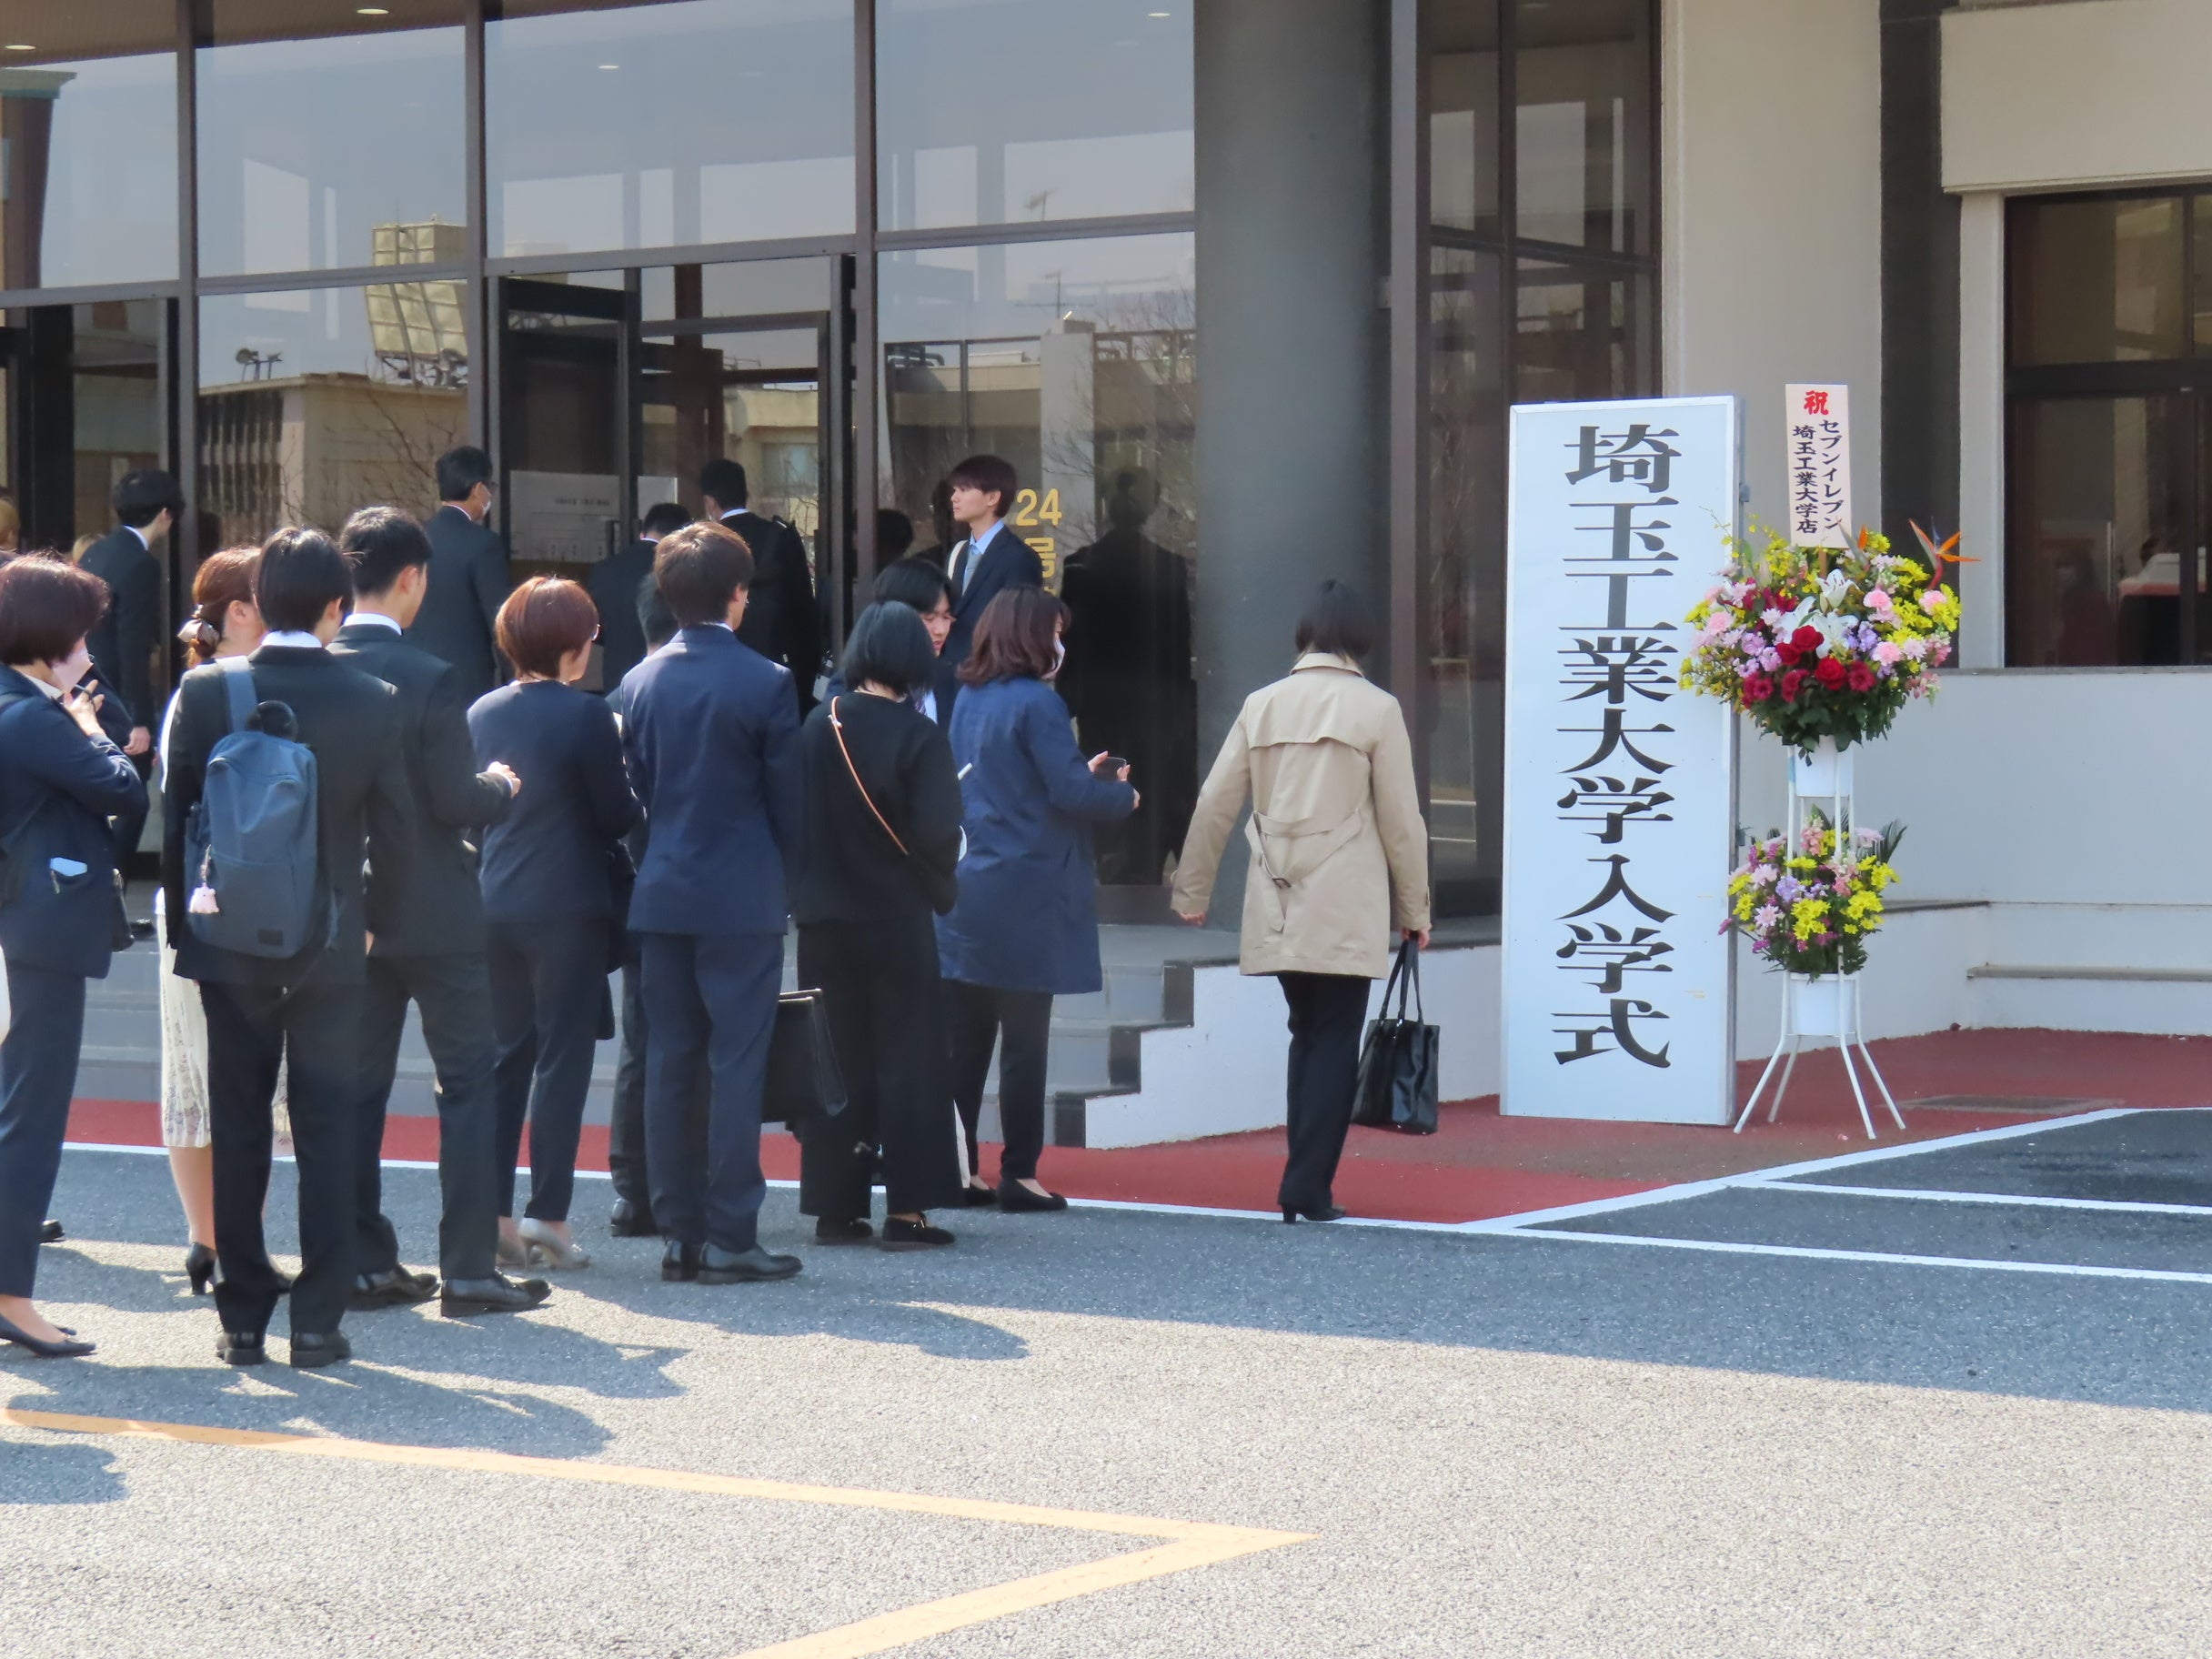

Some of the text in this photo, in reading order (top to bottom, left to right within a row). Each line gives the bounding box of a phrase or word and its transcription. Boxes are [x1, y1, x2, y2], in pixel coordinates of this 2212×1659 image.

[1804, 390, 1829, 416] 祝
[1792, 425, 1819, 534] 埼玉工業大学店
[1819, 419, 1845, 530] セブンイレブン
[1552, 424, 1683, 1068] 埼玉工業大学入学式
